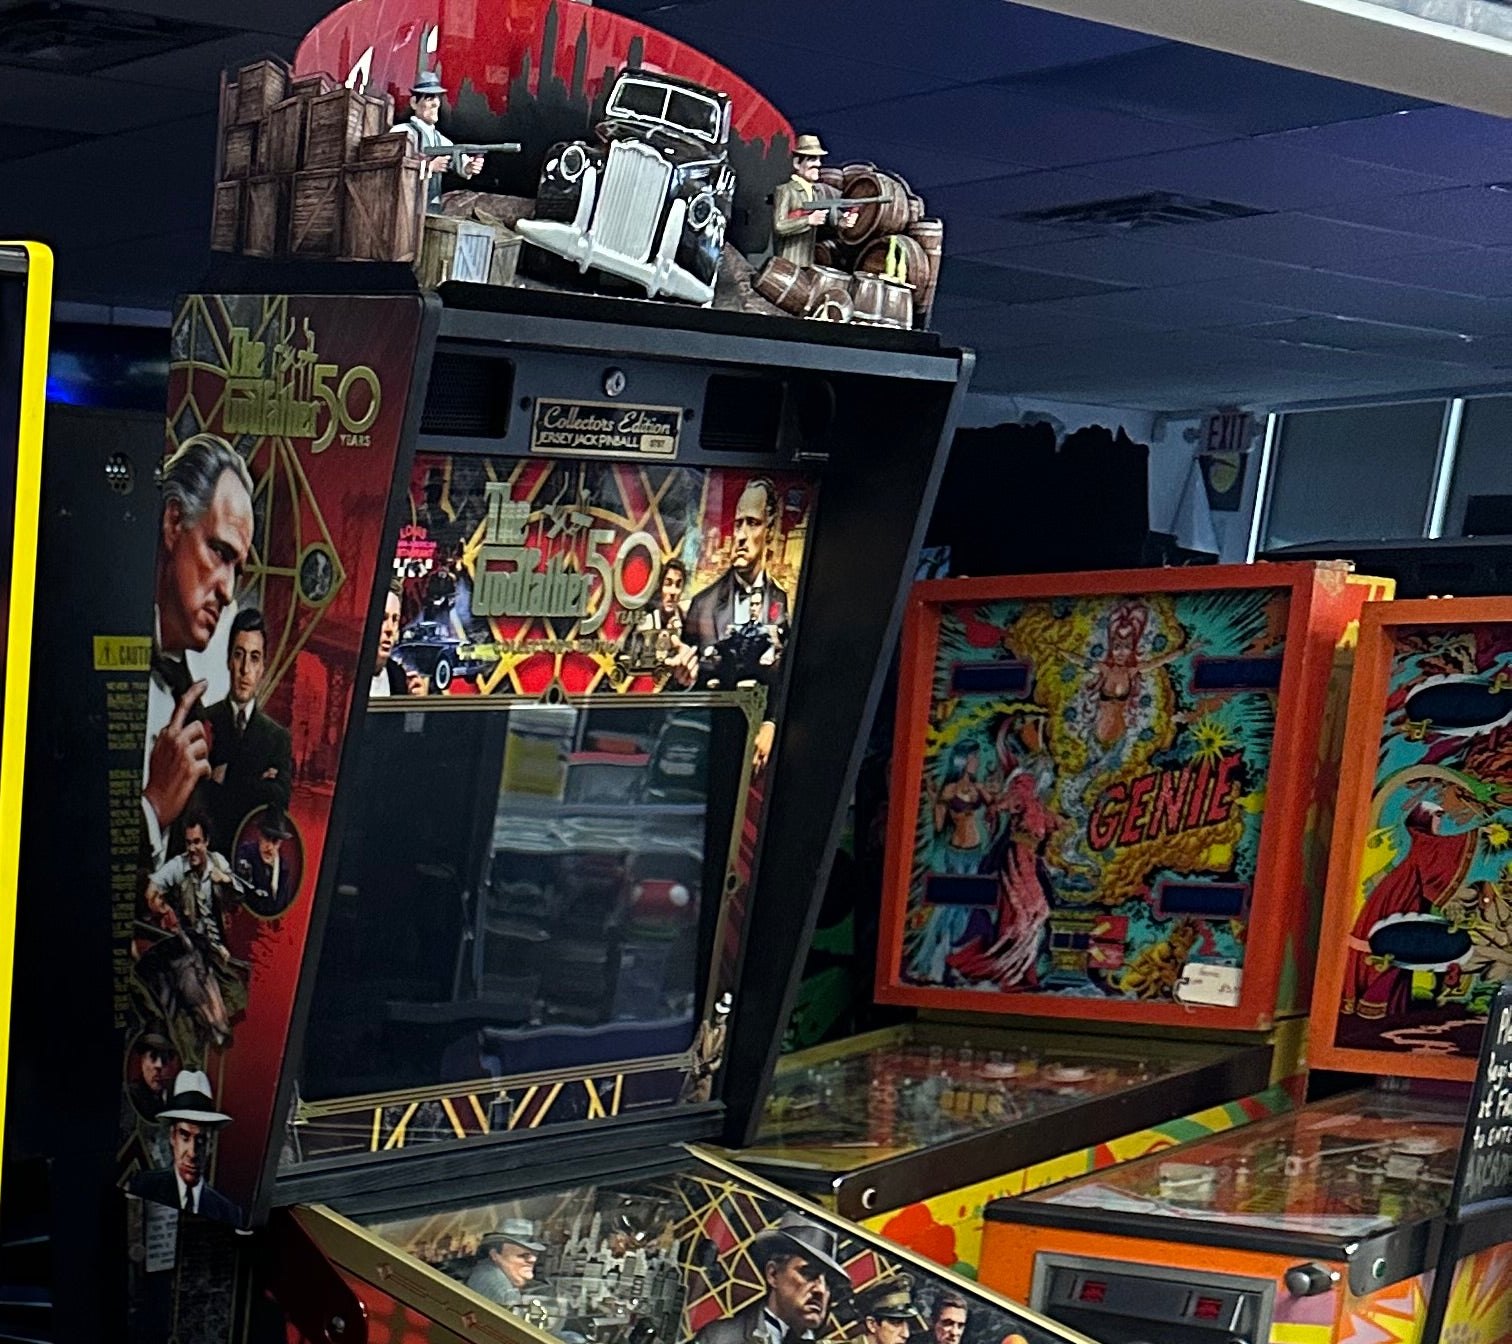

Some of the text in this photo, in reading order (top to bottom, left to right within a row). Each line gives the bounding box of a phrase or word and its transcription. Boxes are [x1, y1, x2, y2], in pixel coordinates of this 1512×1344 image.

[312, 364, 381, 454] 50
[544, 406, 671, 434] Collectors Edition
[340, 434, 372, 447] YEARS
[537, 431, 573, 445] JERSEY
[572, 434, 598, 447] JACK
[598, 434, 640, 448] PINBALL
[485, 482, 531, 544] The
[472, 529, 662, 635] Godfather 50
[119, 645, 151, 665] CAUTI
[1090, 752, 1241, 850] GENIE
